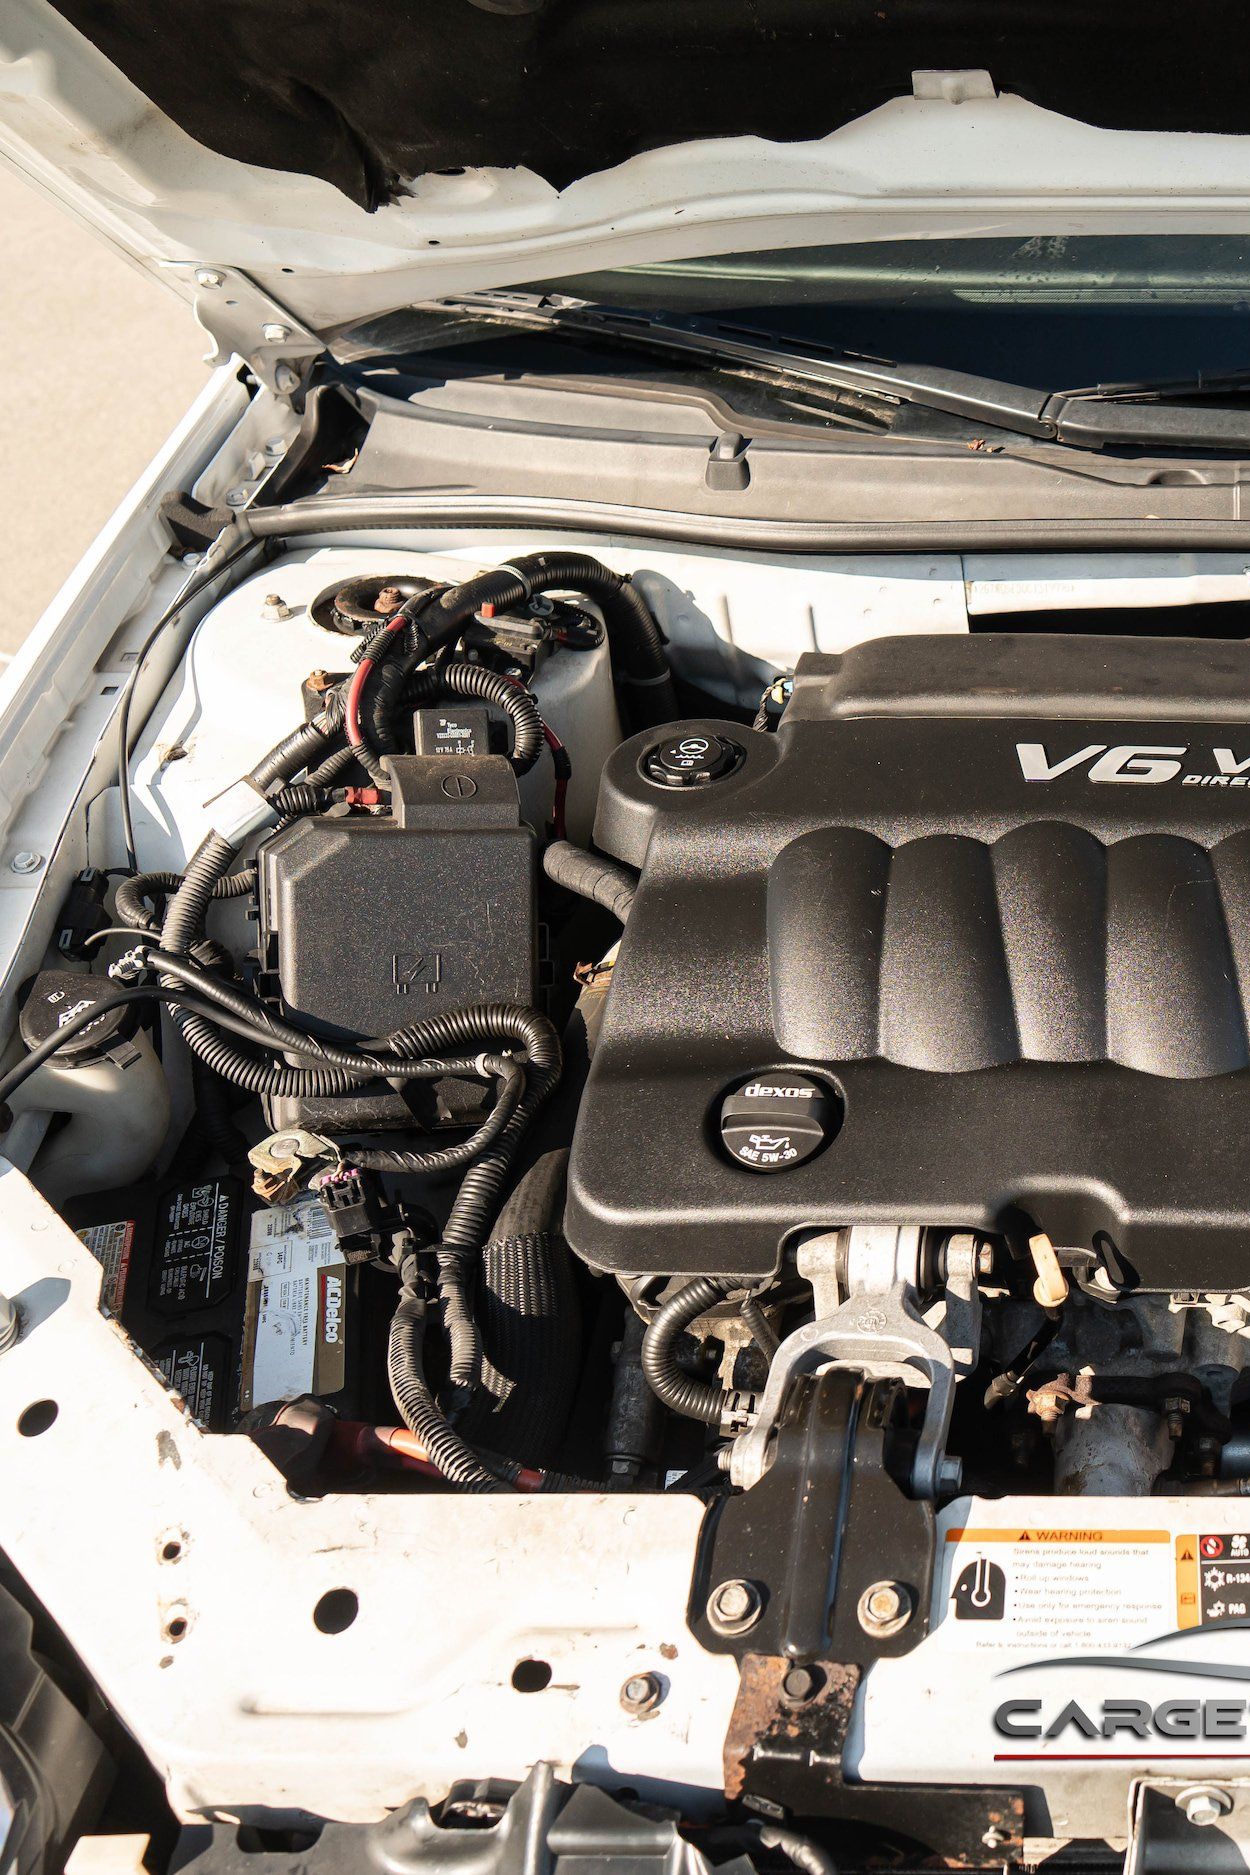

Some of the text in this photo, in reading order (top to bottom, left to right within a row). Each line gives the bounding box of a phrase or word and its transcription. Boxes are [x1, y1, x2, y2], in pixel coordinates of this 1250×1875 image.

[1016, 743, 1188, 783] V6
[744, 1084, 816, 1098] dexos
[740, 1146, 798, 1163] SAE 5W-30
[216, 1203, 229, 1238] DANGER
[211, 1246, 225, 1279] POISON
[325, 1276, 342, 1343] ACDelco
[1036, 1531, 1103, 1542] WARNING
